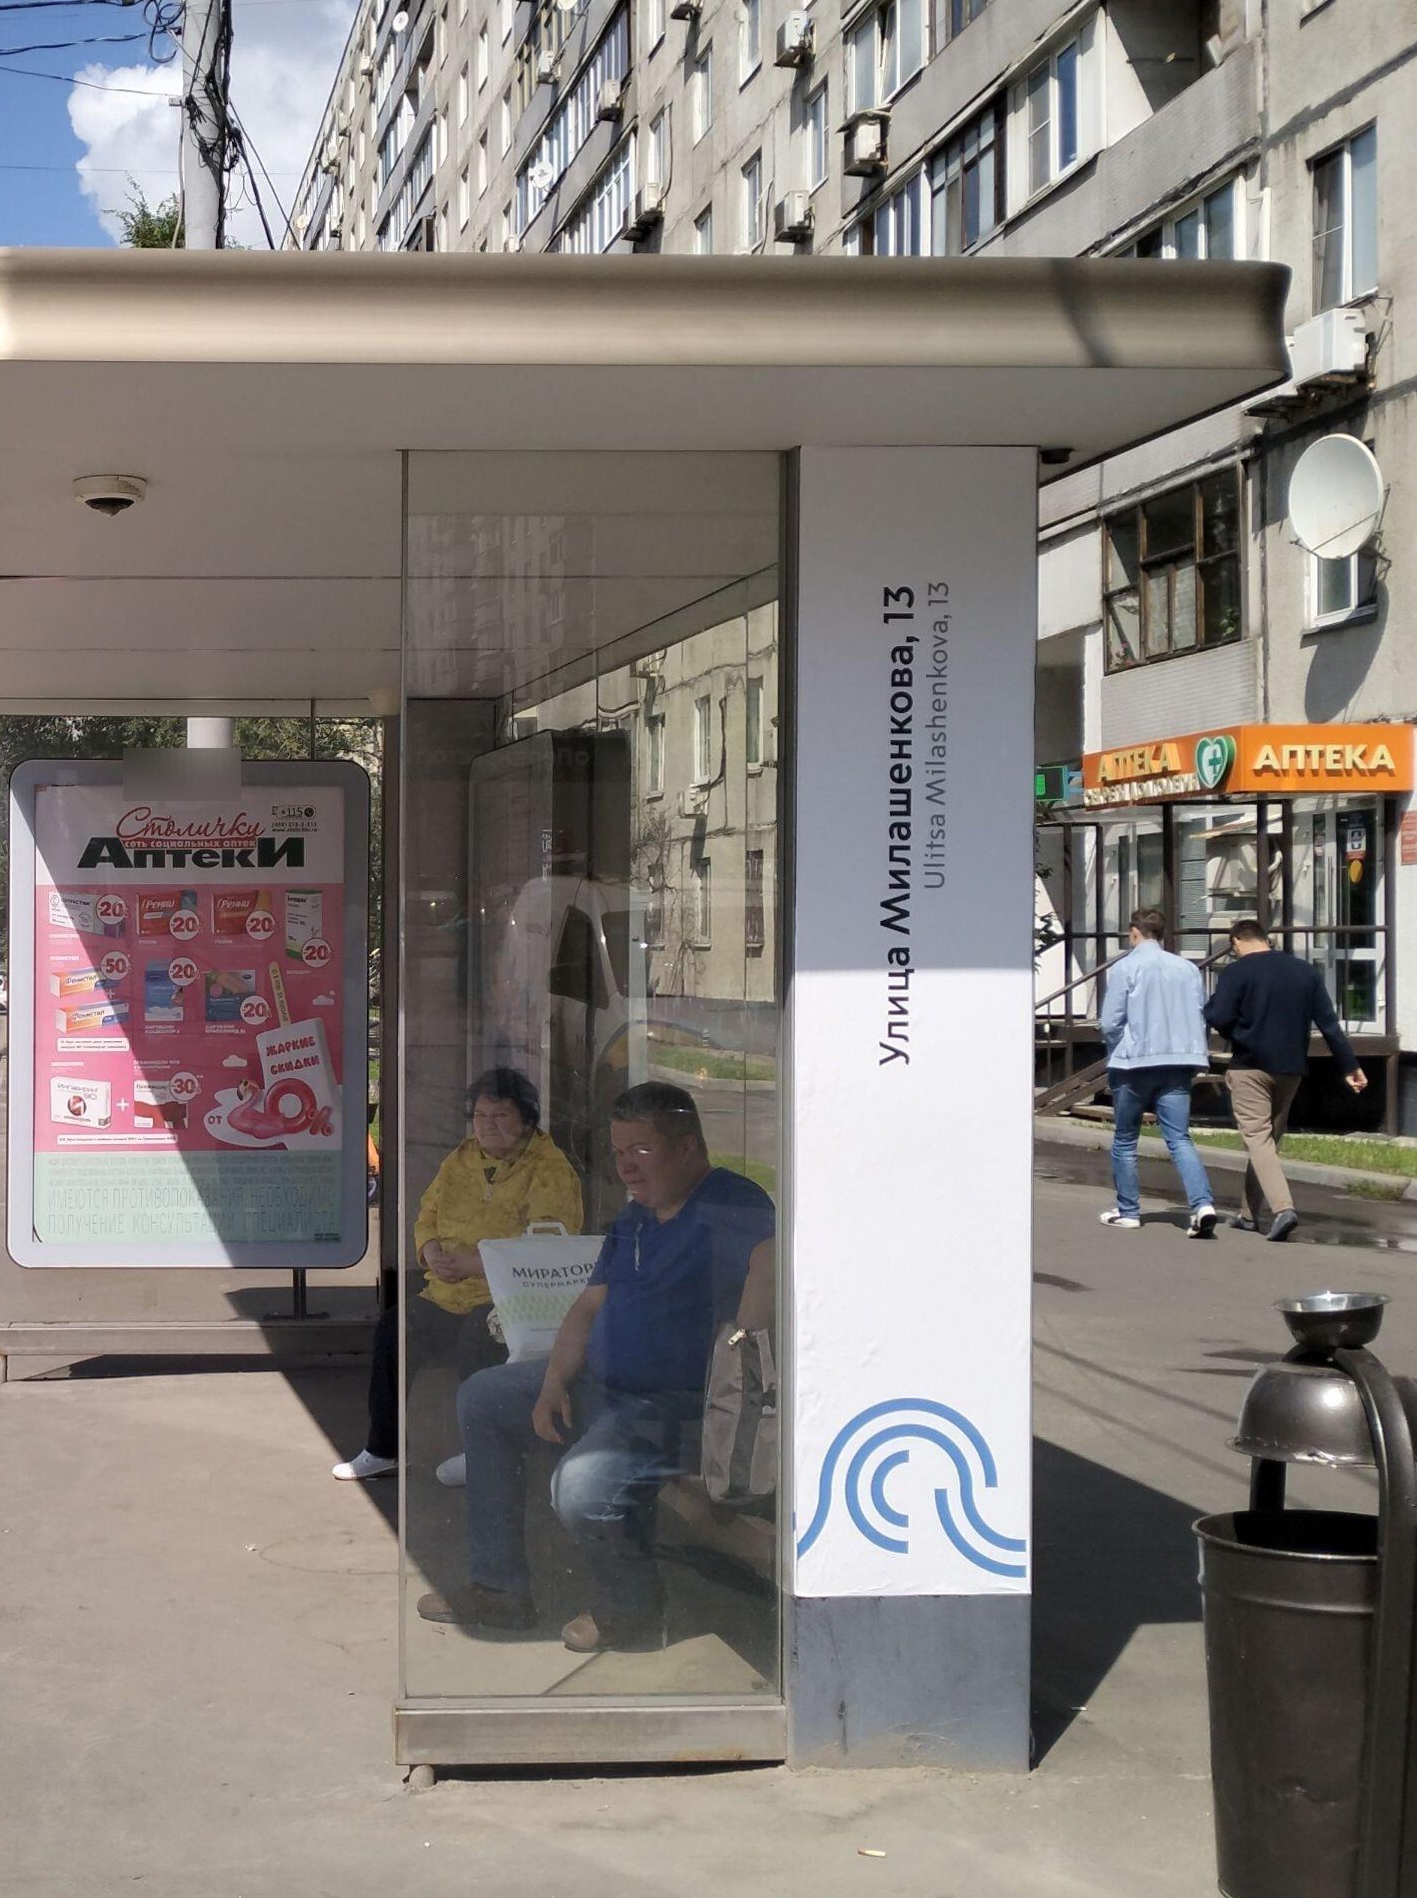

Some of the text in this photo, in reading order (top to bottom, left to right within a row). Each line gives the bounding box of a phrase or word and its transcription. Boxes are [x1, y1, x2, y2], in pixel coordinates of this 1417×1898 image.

[924, 582, 952, 889] Ulitsa Milashenkova, 13
[1097, 743, 1181, 782] АПТЕКА
[1253, 744, 1396, 775] АПТЕКА
[115, 806, 266, 840] Столички
[879, 585, 919, 1066] Улица Милашенкова, 13
[150, 840, 221, 849] социальных
[223, 839, 256, 848] аптек
[266, 1036, 317, 1057] ЖАРКИЕ
[270, 1055, 320, 1076] СКИДКИ
[512, 1262, 595, 1280] МИРАТОР
[522, 1278, 587, 1289] СУПЕРМАРК
